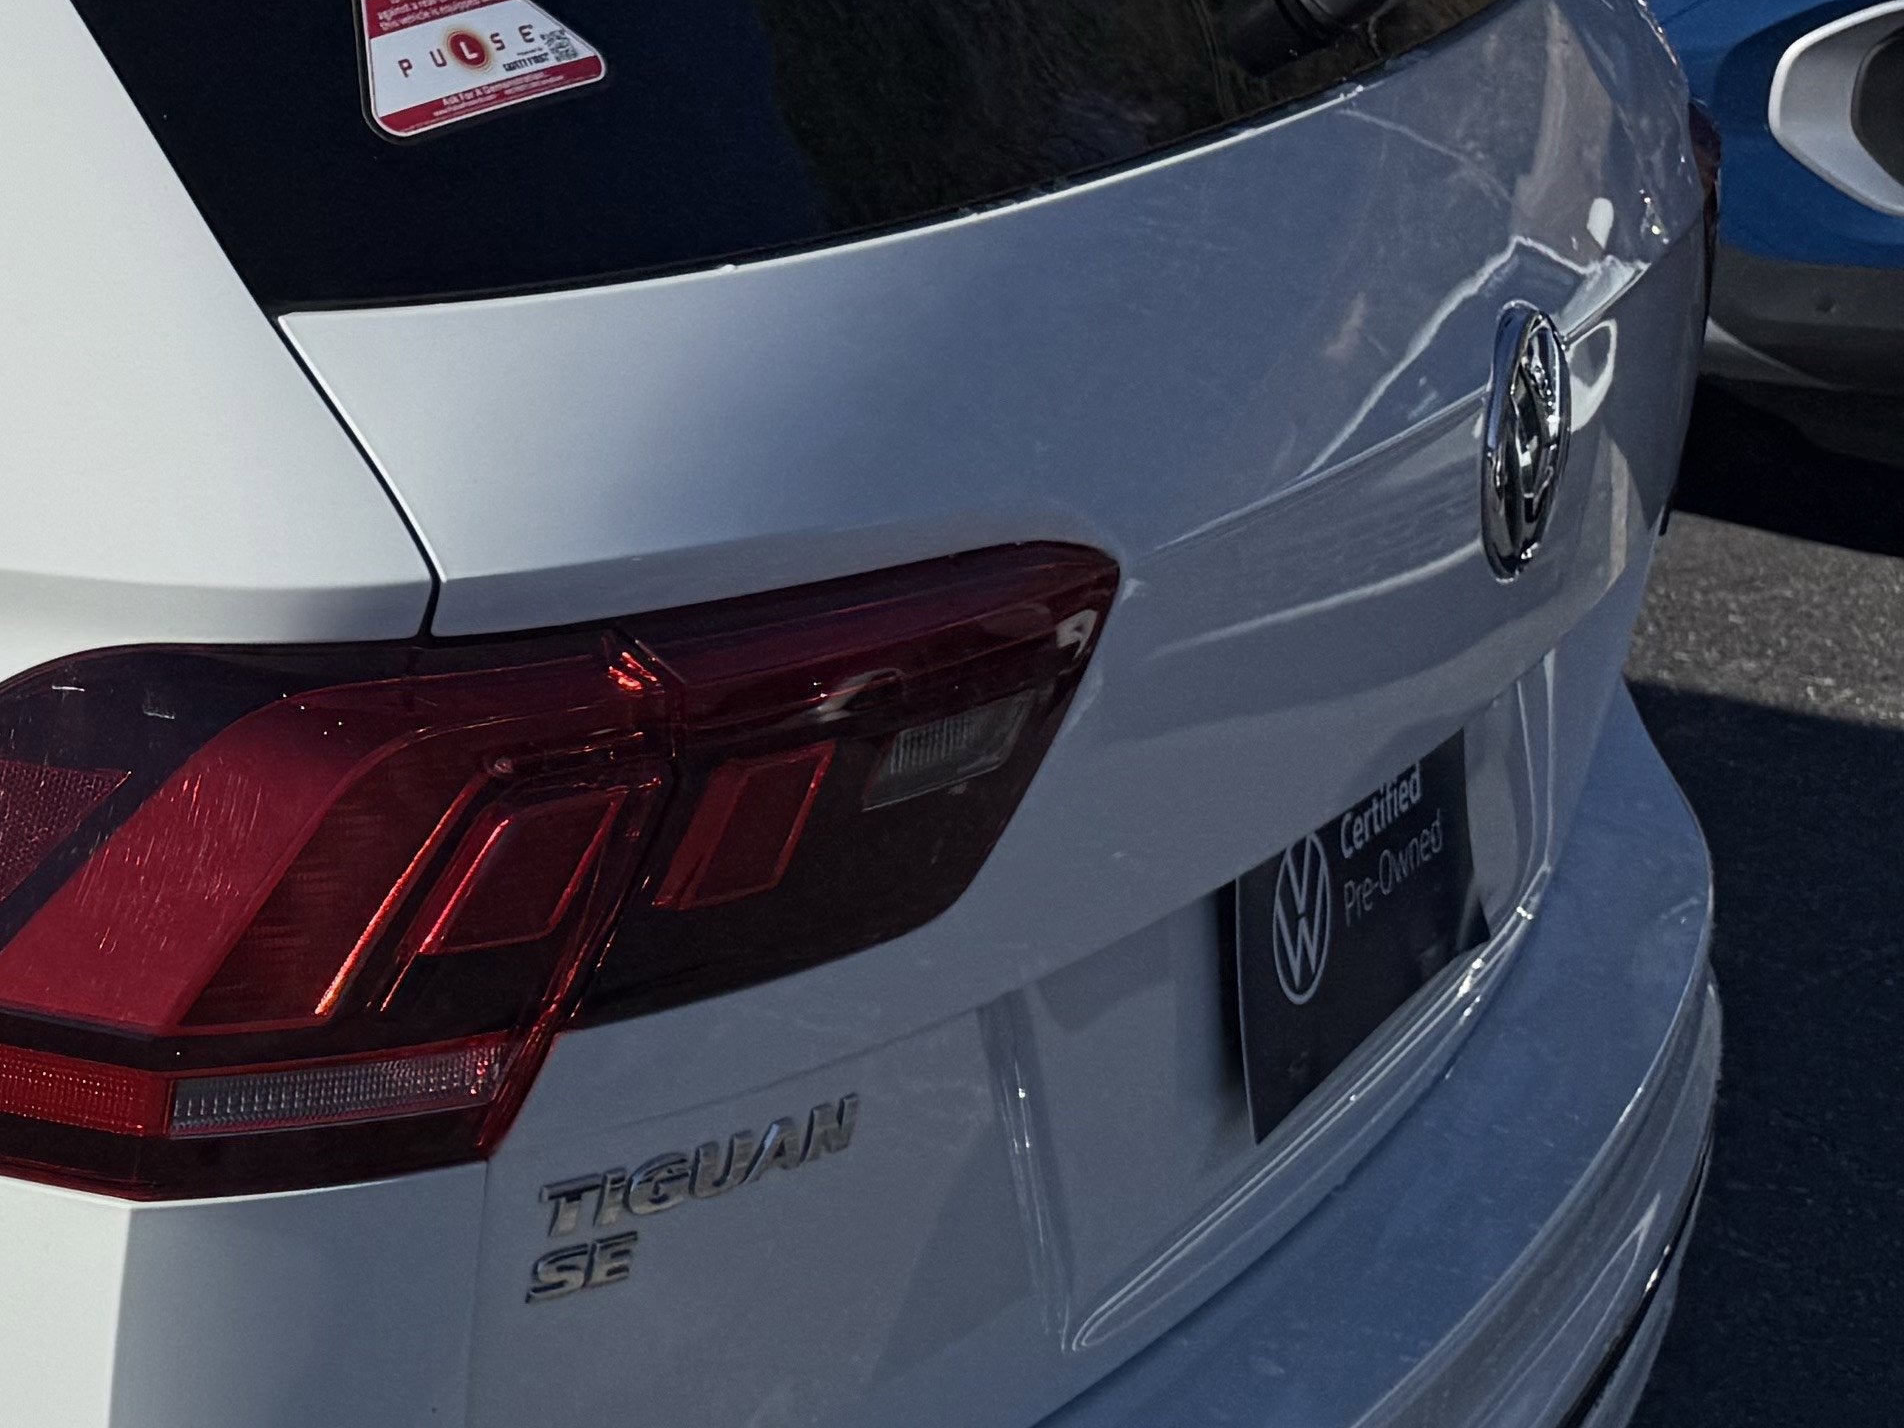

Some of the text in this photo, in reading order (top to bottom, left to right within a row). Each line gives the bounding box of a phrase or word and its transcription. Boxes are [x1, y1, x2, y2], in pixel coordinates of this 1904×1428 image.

[396, 23, 535, 79] PULSE
[1339, 759, 1422, 860] Certified
[1342, 808, 1444, 928] Pre-Owned
[538, 1092, 860, 1238] TIGUAN
[524, 1230, 639, 1305] SE
